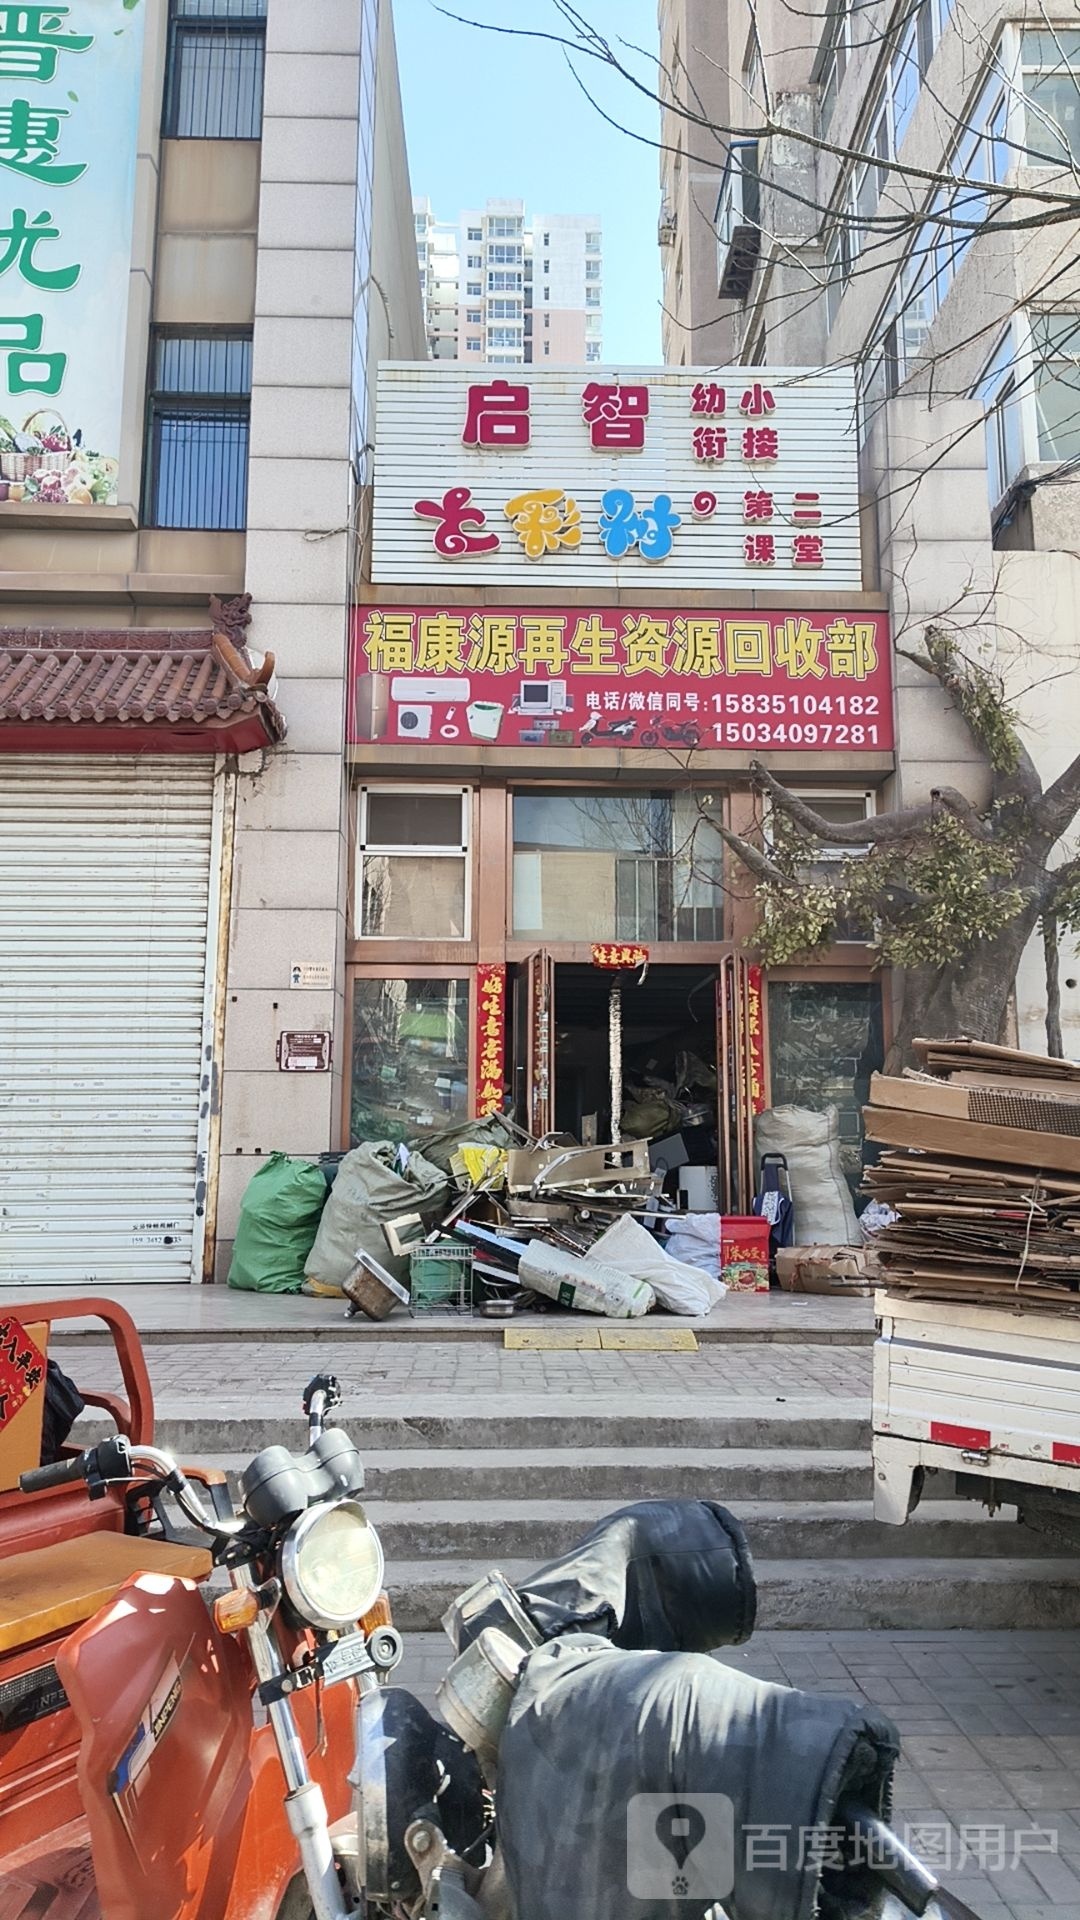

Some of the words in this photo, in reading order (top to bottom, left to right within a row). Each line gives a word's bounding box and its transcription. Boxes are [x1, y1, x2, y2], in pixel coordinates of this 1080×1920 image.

[462, 379, 650, 451] 启智
[691, 382, 777, 418] 幼小
[692, 427, 779, 463] 衔接
[743, 490, 824, 524] 第二
[744, 533, 825, 568] 课堂
[362, 611, 879, 680] 福康源再生资源回收部
[711, 693, 879, 716] 15835104182
[713, 722, 879, 745] 15034097281
[153, 1681, 181, 1734] JINPENG
